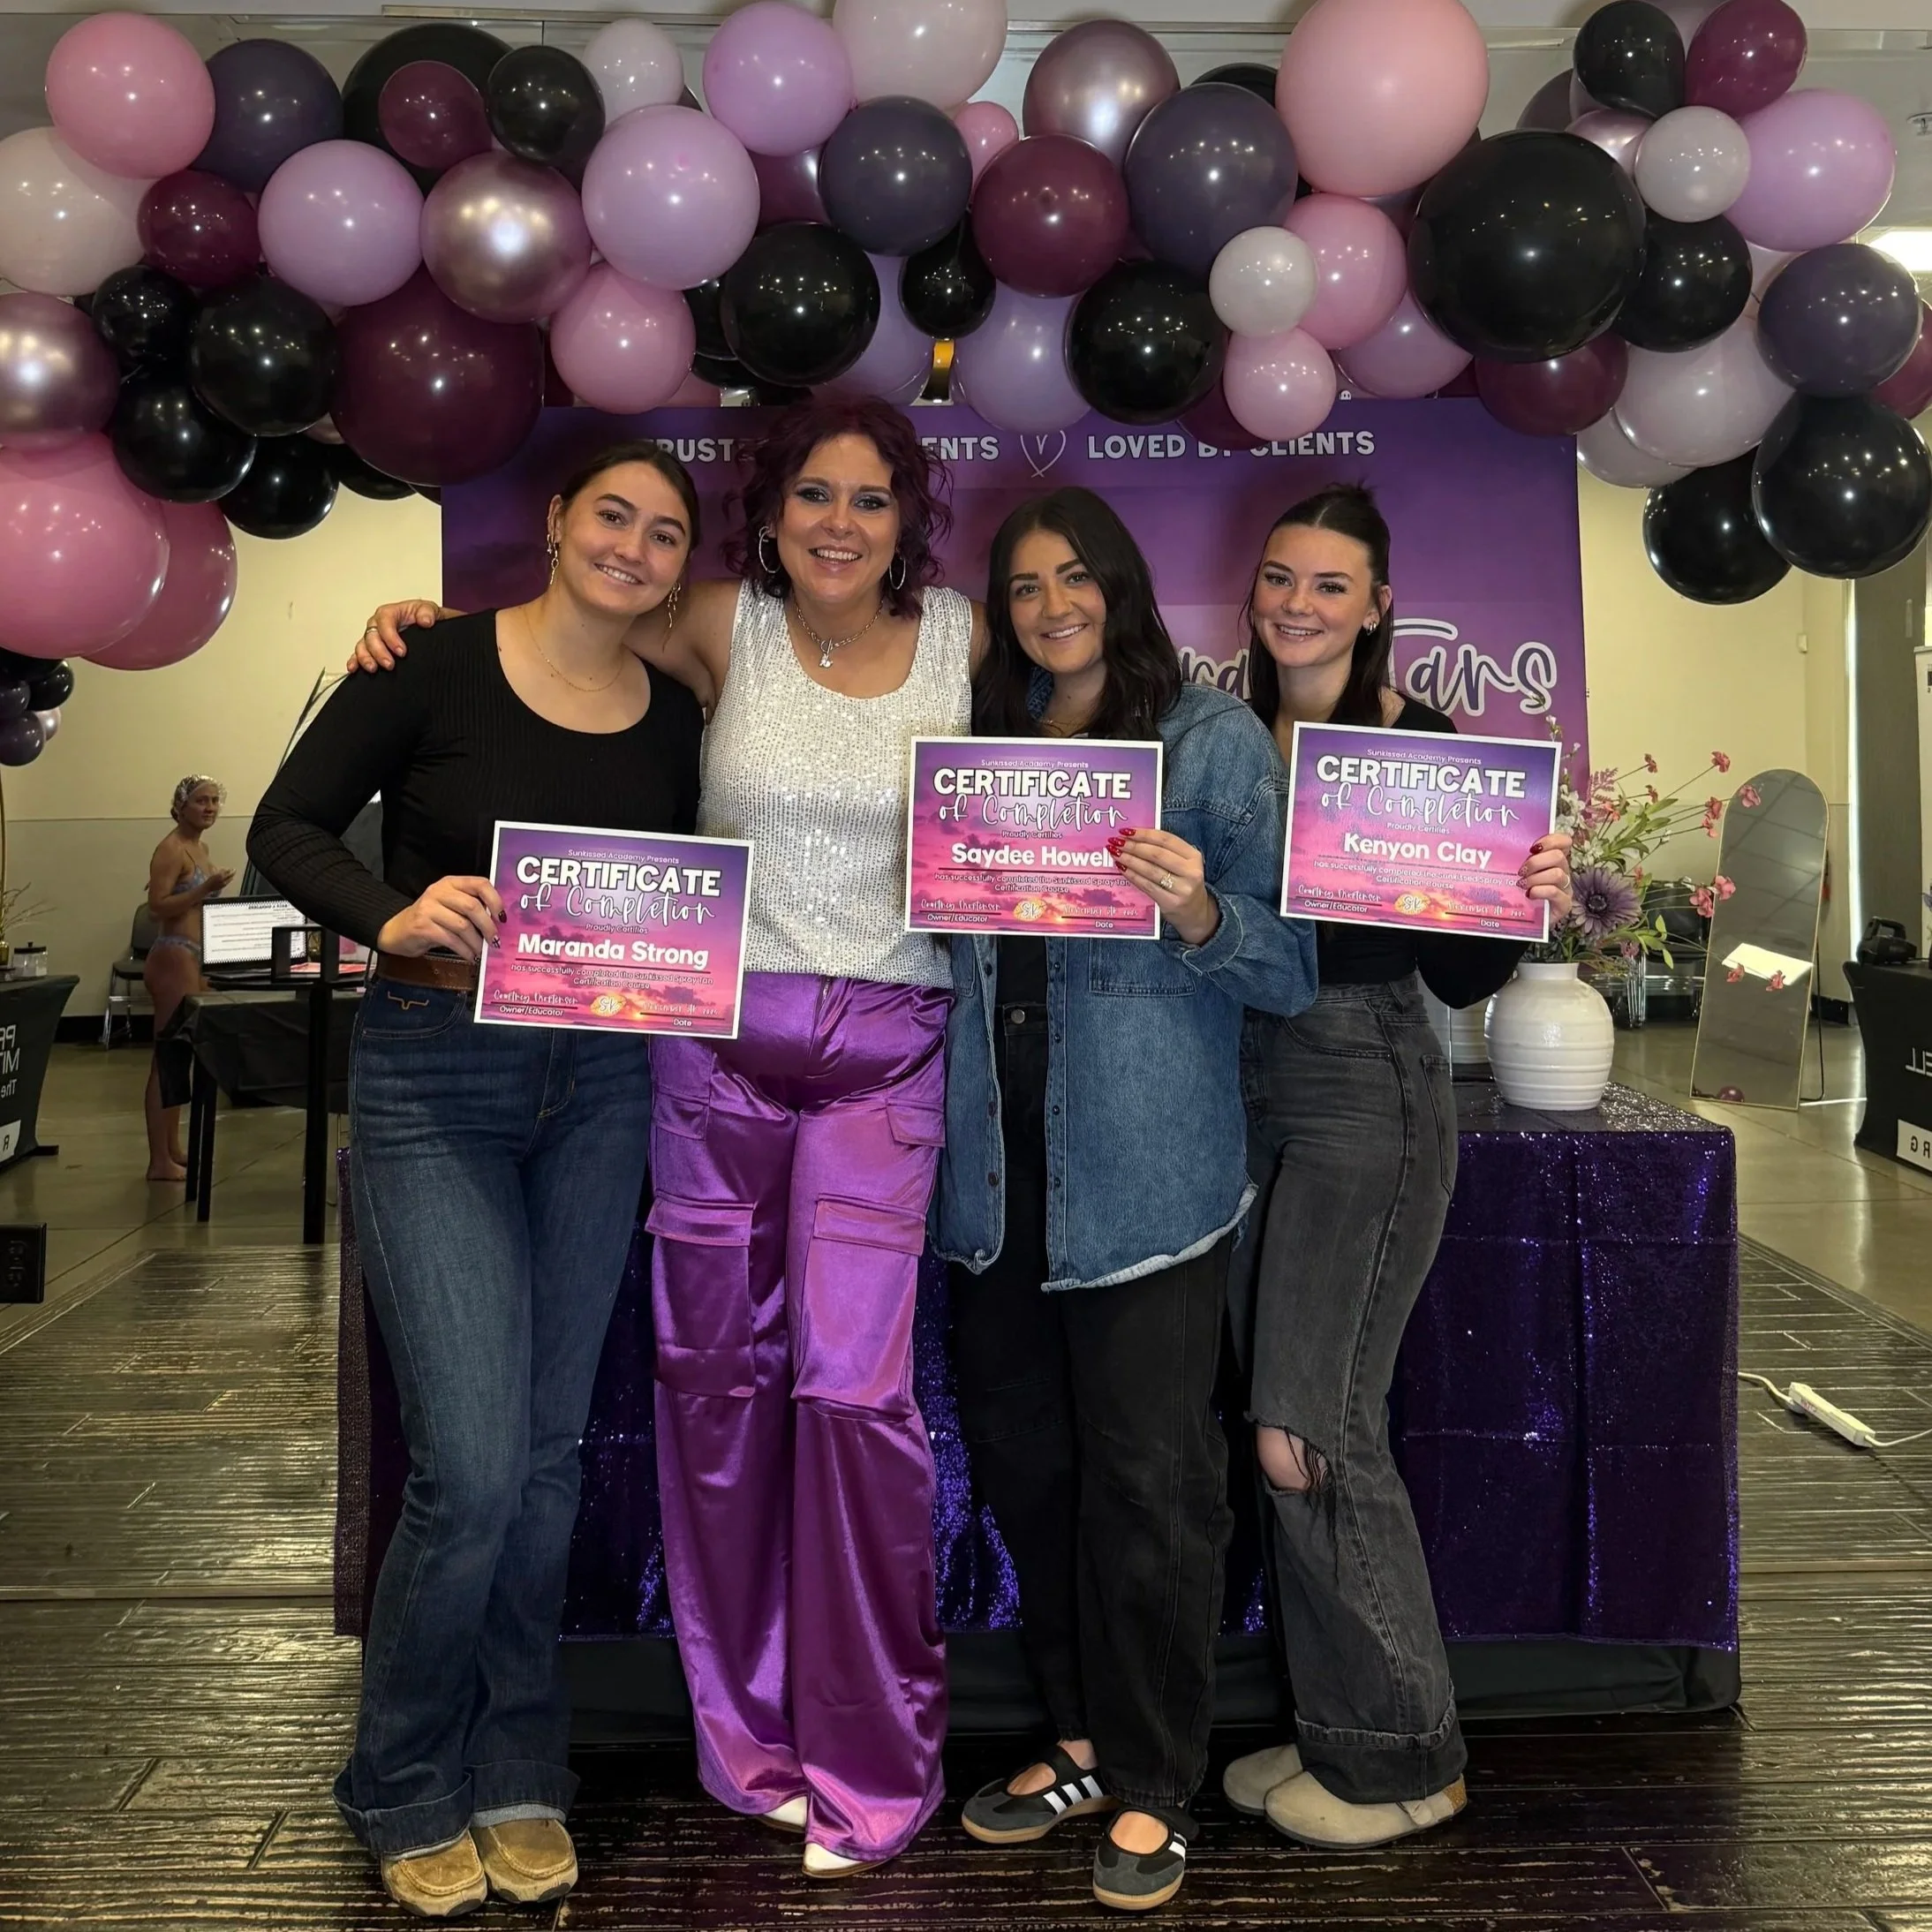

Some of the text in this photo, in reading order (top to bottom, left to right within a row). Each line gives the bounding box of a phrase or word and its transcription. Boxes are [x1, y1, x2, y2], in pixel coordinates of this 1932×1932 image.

[921, 435, 1000, 461] ENTS
[1088, 434, 1186, 459] LOVED
[1019, 760, 1055, 769] Academy
[1367, 749, 1482, 765] Sunkissed Academy Presents
[933, 767, 1132, 800] CERTIFICATE
[1316, 754, 1527, 799] CERTIFICATE
[938, 792, 1128, 832] of Completion
[1320, 781, 1521, 828] of Completion
[1001, 830, 1030, 840] Proudly
[1386, 822, 1416, 833] Proudly
[568, 849, 680, 864] Sunkissed Academy Presents
[951, 842, 1036, 869] Saydee
[1343, 832, 1492, 871] Kenyon Clay
[516, 855, 722, 898] CERTIFICATE
[519, 882, 716, 927] of Completion
[1304, 901, 1368, 913] Owner/Educator
[927, 913, 988, 923] Owner/Educator
[1480, 919, 1500, 928] Date
[585, 924, 616, 933] Proudly
[517, 933, 709, 970] Maranda Strong
[499, 1005, 565, 1017] Owner/Educator
[673, 1017, 692, 1027] Date
